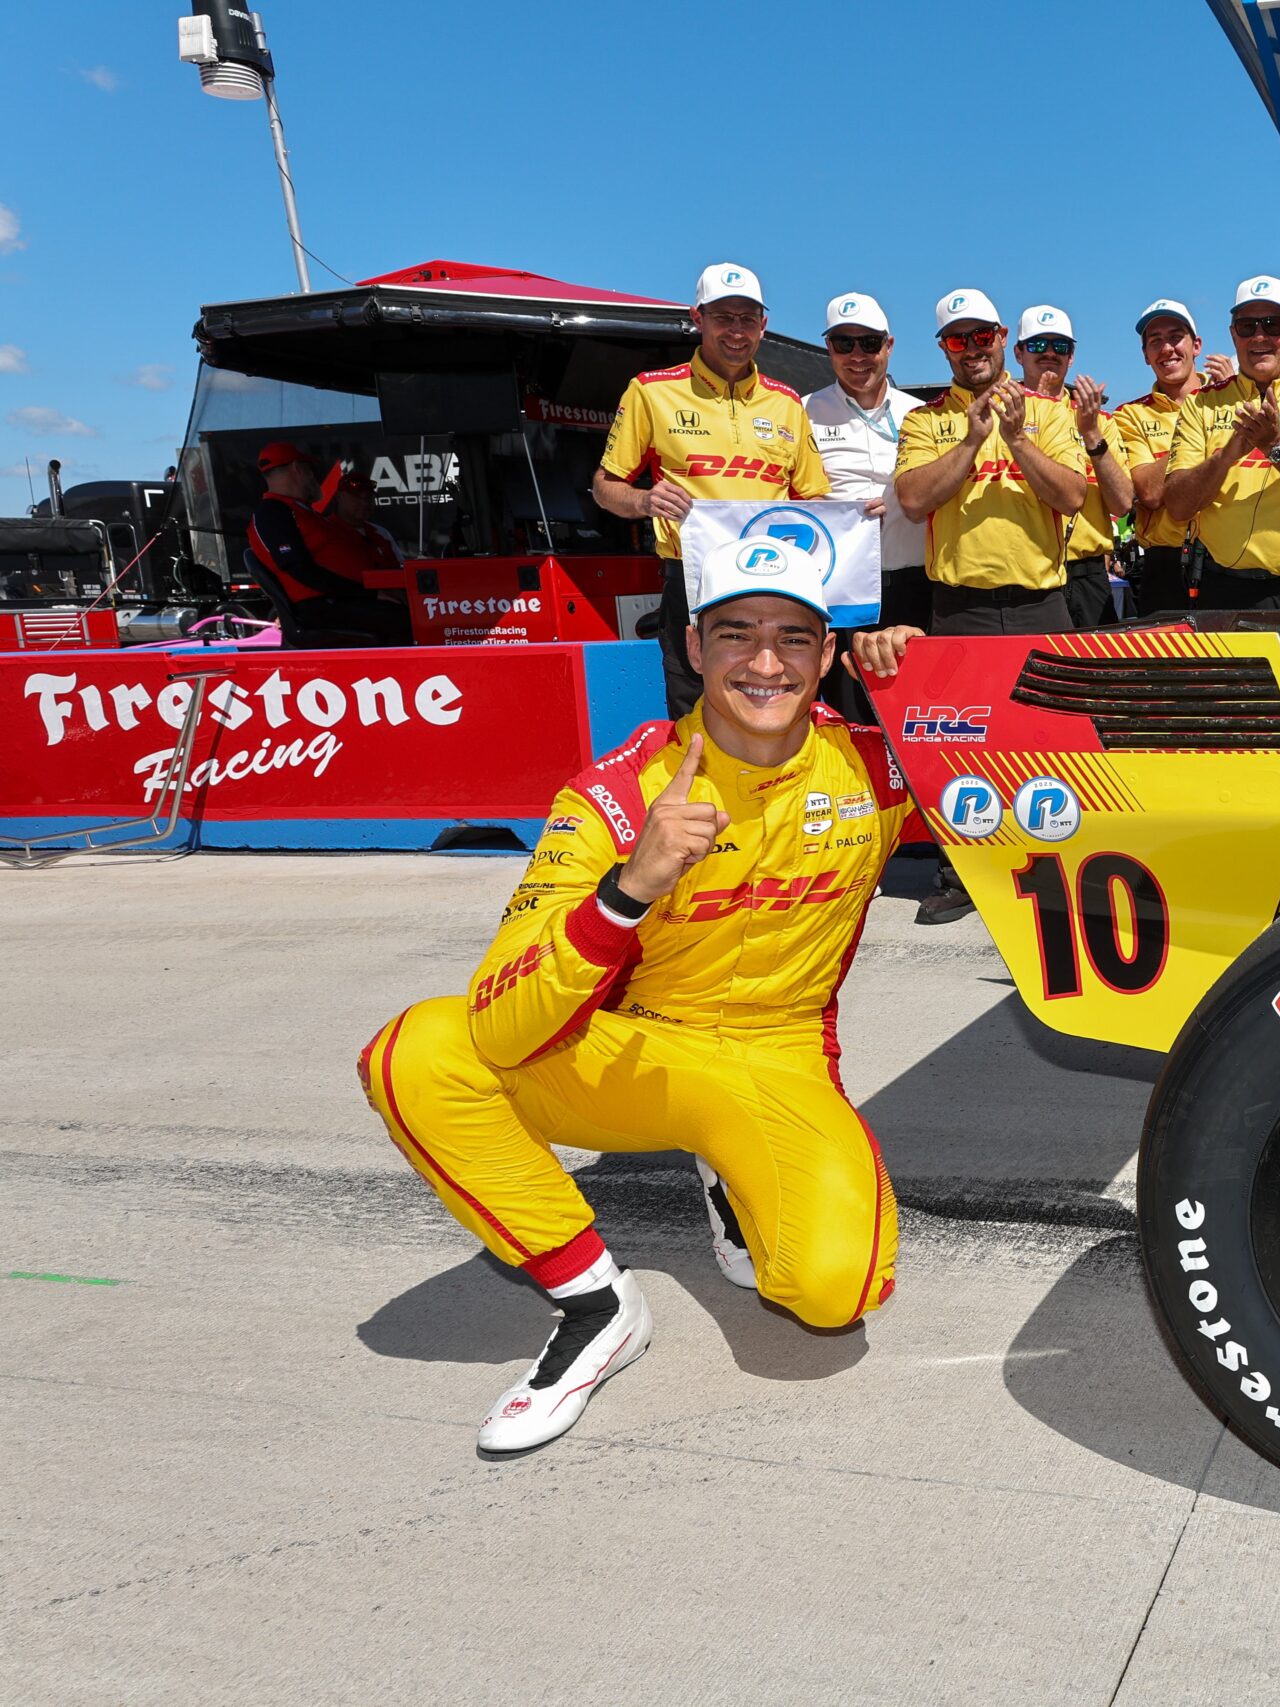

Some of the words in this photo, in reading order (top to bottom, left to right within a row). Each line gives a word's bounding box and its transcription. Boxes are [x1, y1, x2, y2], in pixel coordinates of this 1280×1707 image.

[668, 427, 711, 436] HONDA
[685, 454, 786, 486] DHL
[423, 597, 542, 619] Firestone
[444, 626, 527, 636] @FirestoneRacing
[24, 667, 464, 747] Firestone
[903, 706, 991, 736] HRC
[595, 726, 656, 771] Firestone
[903, 735, 942, 743] Honda
[134, 731, 343, 803] Racing
[756, 771, 798, 792] DHL
[588, 783, 635, 845] sparco
[810, 798, 827, 806] NTT
[824, 841, 832, 850] A.
[836, 833, 872, 848] PALOU
[537, 851, 574, 866] PNC
[687, 870, 849, 923] DHL
[1011, 851, 1170, 1001] 10
[476, 944, 541, 1013] DHL
